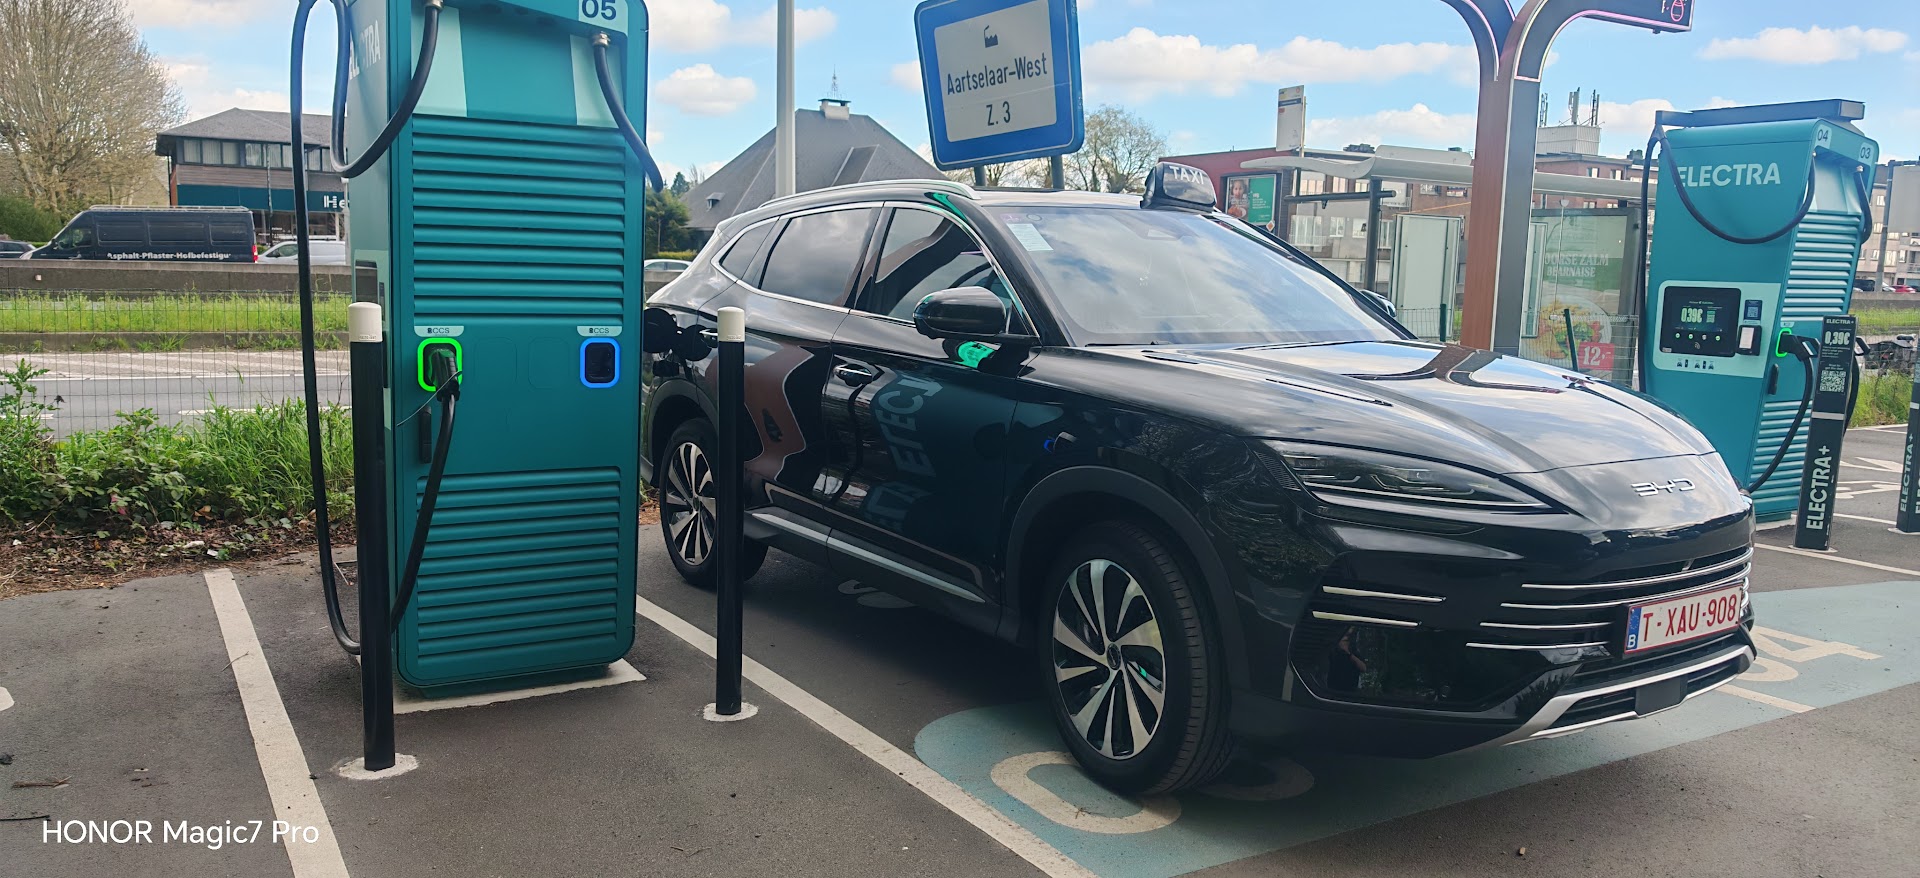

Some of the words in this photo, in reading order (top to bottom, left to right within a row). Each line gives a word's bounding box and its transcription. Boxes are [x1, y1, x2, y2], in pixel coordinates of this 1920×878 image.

[581, 0, 617, 21] 05
[947, 52, 1048, 96] Aartselaar-West
[1002, 100, 1012, 124] 3
[1816, 128, 1829, 142] 04
[1859, 146, 1872, 160] 03
[1168, 165, 1205, 185] TAXI
[1674, 162, 1781, 188] ELECTRA
[1579, 253, 1609, 267] ZALM
[1824, 330, 1851, 346] 0,39€
[1631, 478, 1696, 497] BYD
[1805, 445, 1832, 530] ELECTRA+
[1627, 633, 1637, 649] B
[1643, 593, 1738, 642] T-XAU-908
